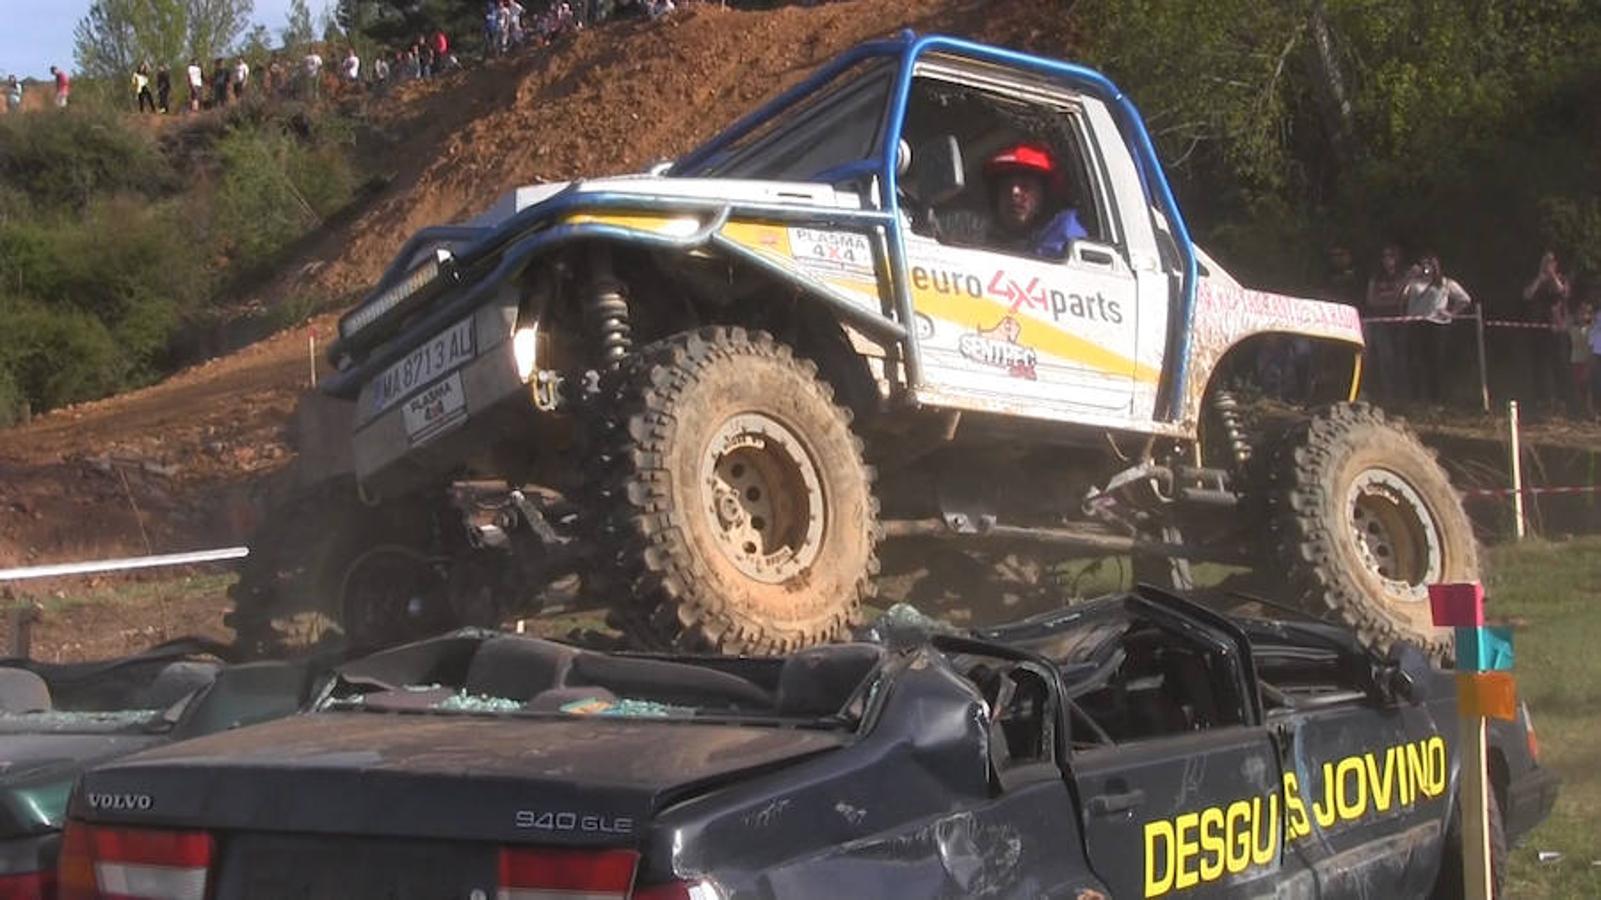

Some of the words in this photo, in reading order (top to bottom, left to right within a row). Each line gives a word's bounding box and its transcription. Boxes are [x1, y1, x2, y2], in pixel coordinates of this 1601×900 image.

[796, 229, 866, 250] PLASMA
[1313, 736, 1446, 829] JOVINO
[88, 793, 153, 809] VOLVO
[516, 810, 576, 830] 940
[581, 815, 633, 833] GLE
